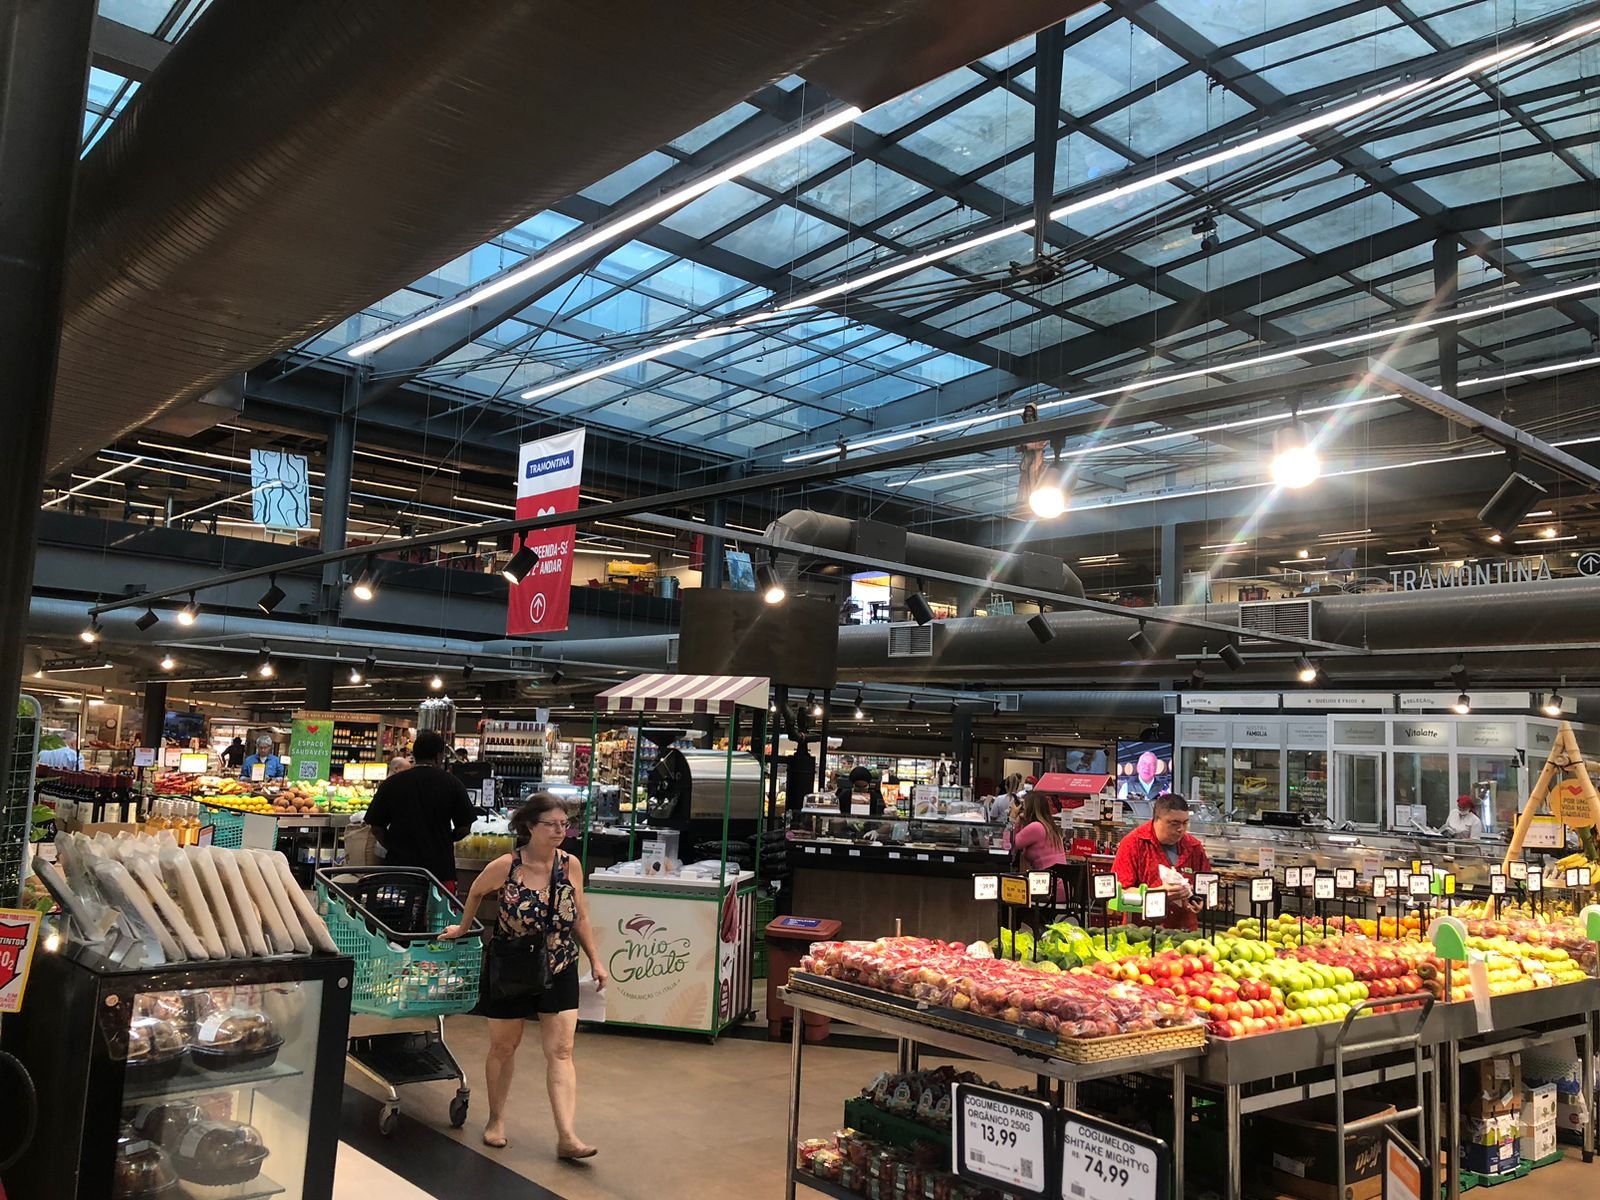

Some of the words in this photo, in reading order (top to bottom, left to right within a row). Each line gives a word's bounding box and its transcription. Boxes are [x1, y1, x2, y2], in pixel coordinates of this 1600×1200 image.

[529, 455, 570, 474] TRAMONTINA
[540, 559, 562, 575] ANDAR
[1389, 559, 1552, 592] TRAMONTINA
[609, 949, 690, 983] Gelato
[965, 1096, 1009, 1114] COGUMELO
[1009, 1107, 1034, 1121] PARIS
[968, 1108, 1010, 1127] ORGÂNICO
[1010, 1120, 1031, 1133] 250G
[981, 1123, 1017, 1148] 13,99
[1078, 1126, 1136, 1155] COGUMELOS
[1064, 1134, 1104, 1157] SHITAKE
[1105, 1150, 1150, 1174] MIGHTYG
[1084, 1154, 1129, 1187] 74,99
